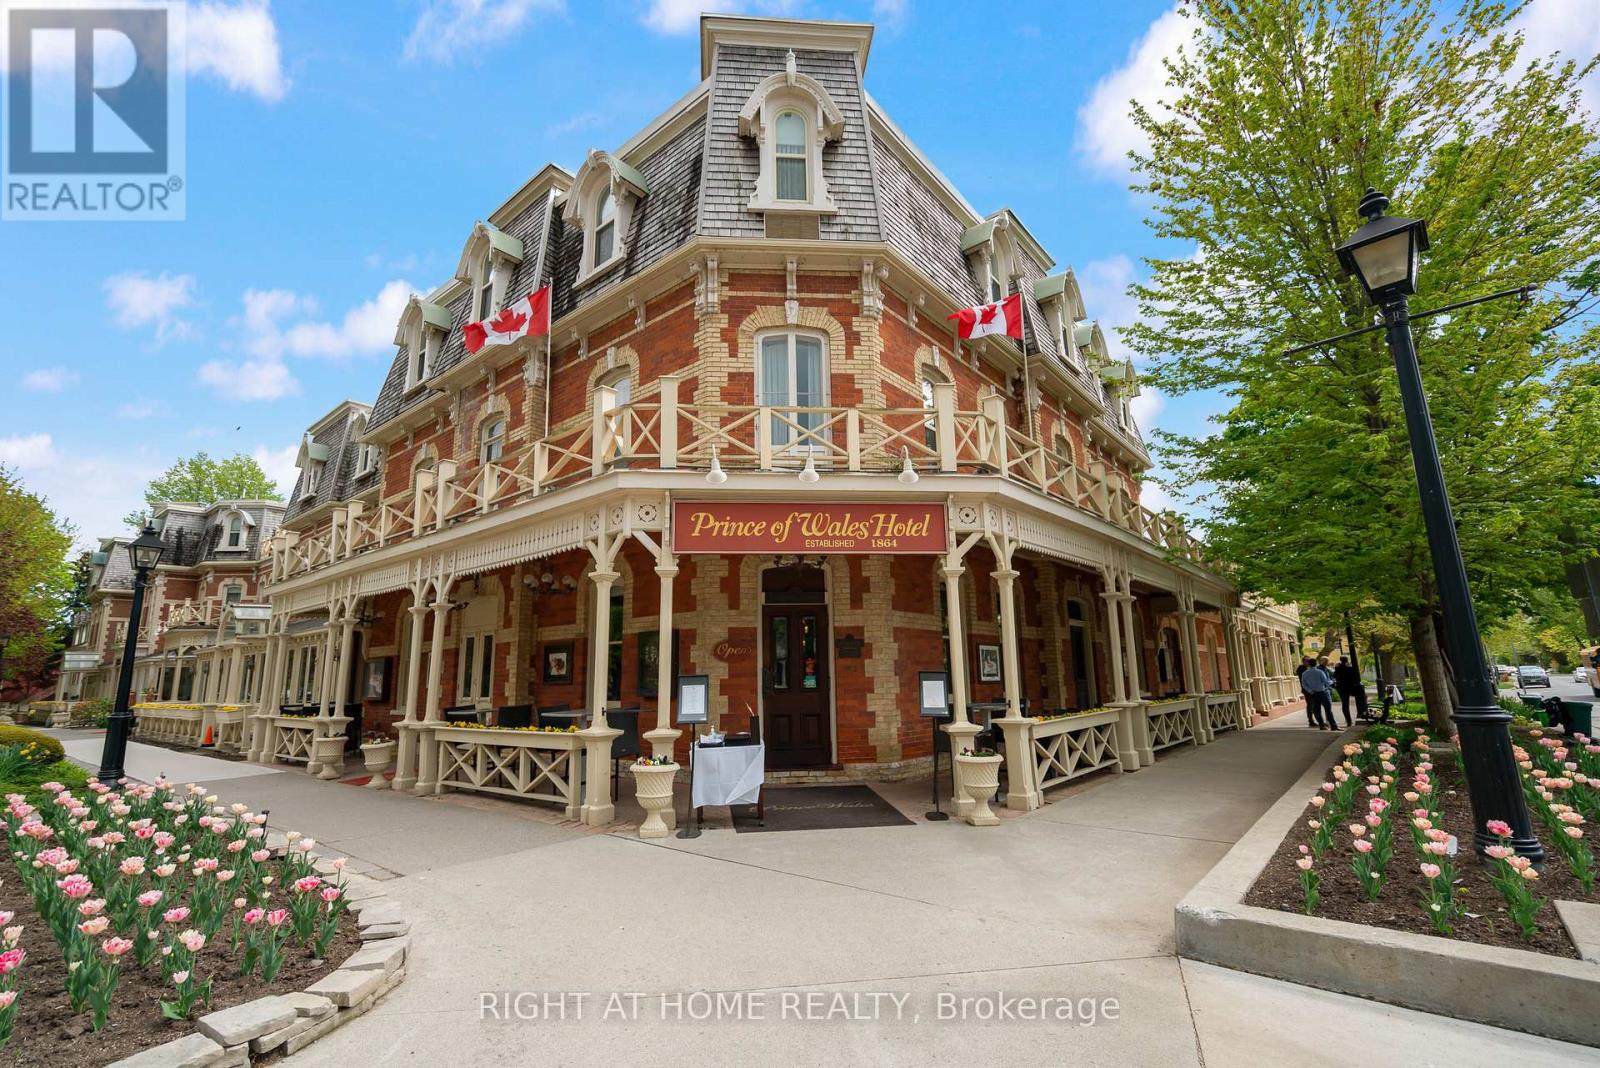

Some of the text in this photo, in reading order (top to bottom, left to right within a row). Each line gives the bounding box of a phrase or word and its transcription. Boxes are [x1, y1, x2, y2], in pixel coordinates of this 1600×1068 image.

[690, 511, 931, 543] Prince of Wales Hotel
[805, 538, 898, 548] ESTABLISHED 1864
